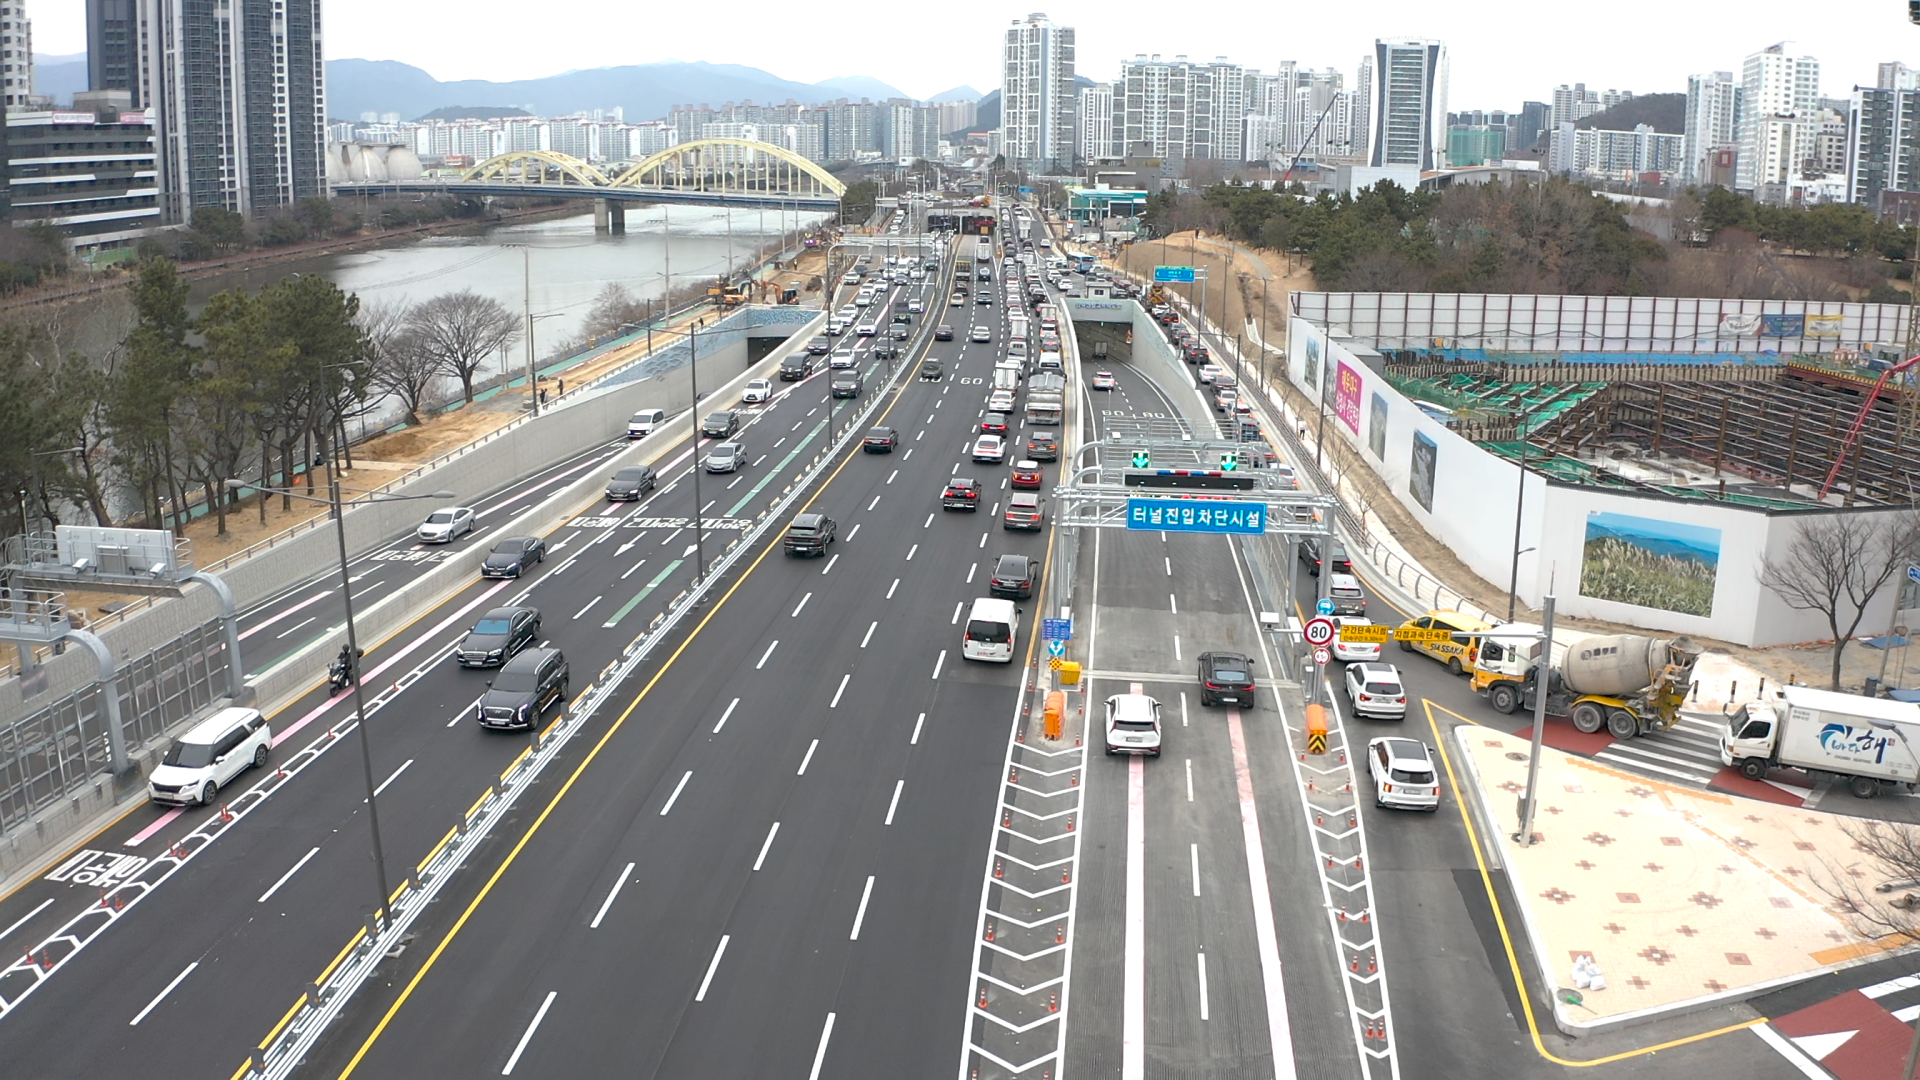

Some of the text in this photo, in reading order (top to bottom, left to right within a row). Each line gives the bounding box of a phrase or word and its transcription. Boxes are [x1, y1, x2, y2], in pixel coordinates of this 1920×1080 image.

[960, 377, 983, 385] 60
[1132, 505, 1260, 528] 터널진입차단시설
[1310, 626, 1328, 639] 80
